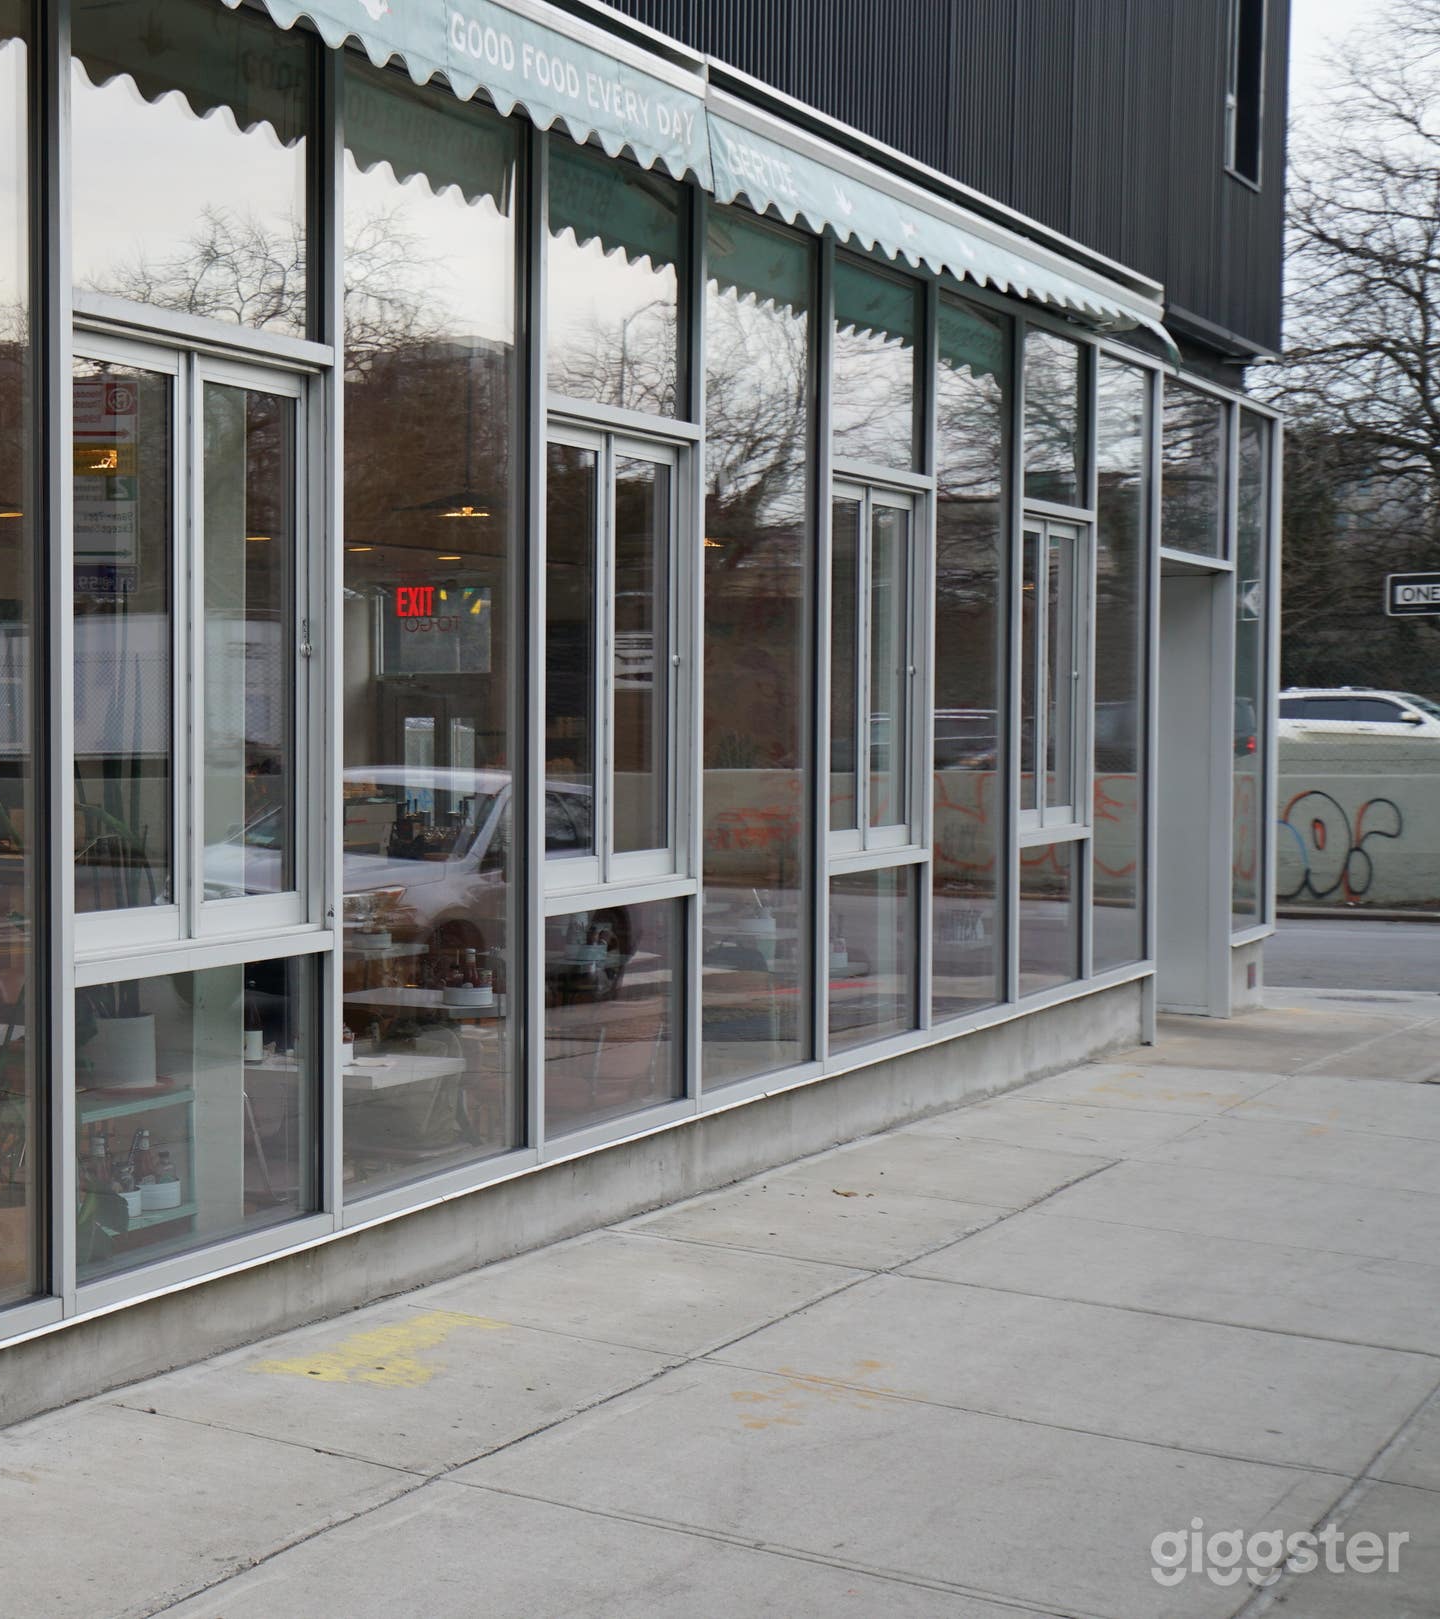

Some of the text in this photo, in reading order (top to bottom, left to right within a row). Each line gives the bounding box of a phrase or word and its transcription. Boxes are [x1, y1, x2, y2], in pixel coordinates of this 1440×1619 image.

[450, 11, 696, 146] GOOD FOOD EVERY DAY
[724, 138, 799, 198] GERTIE
[396, 586, 435, 617] EXIT
[1401, 586, 1440, 602] ONE
